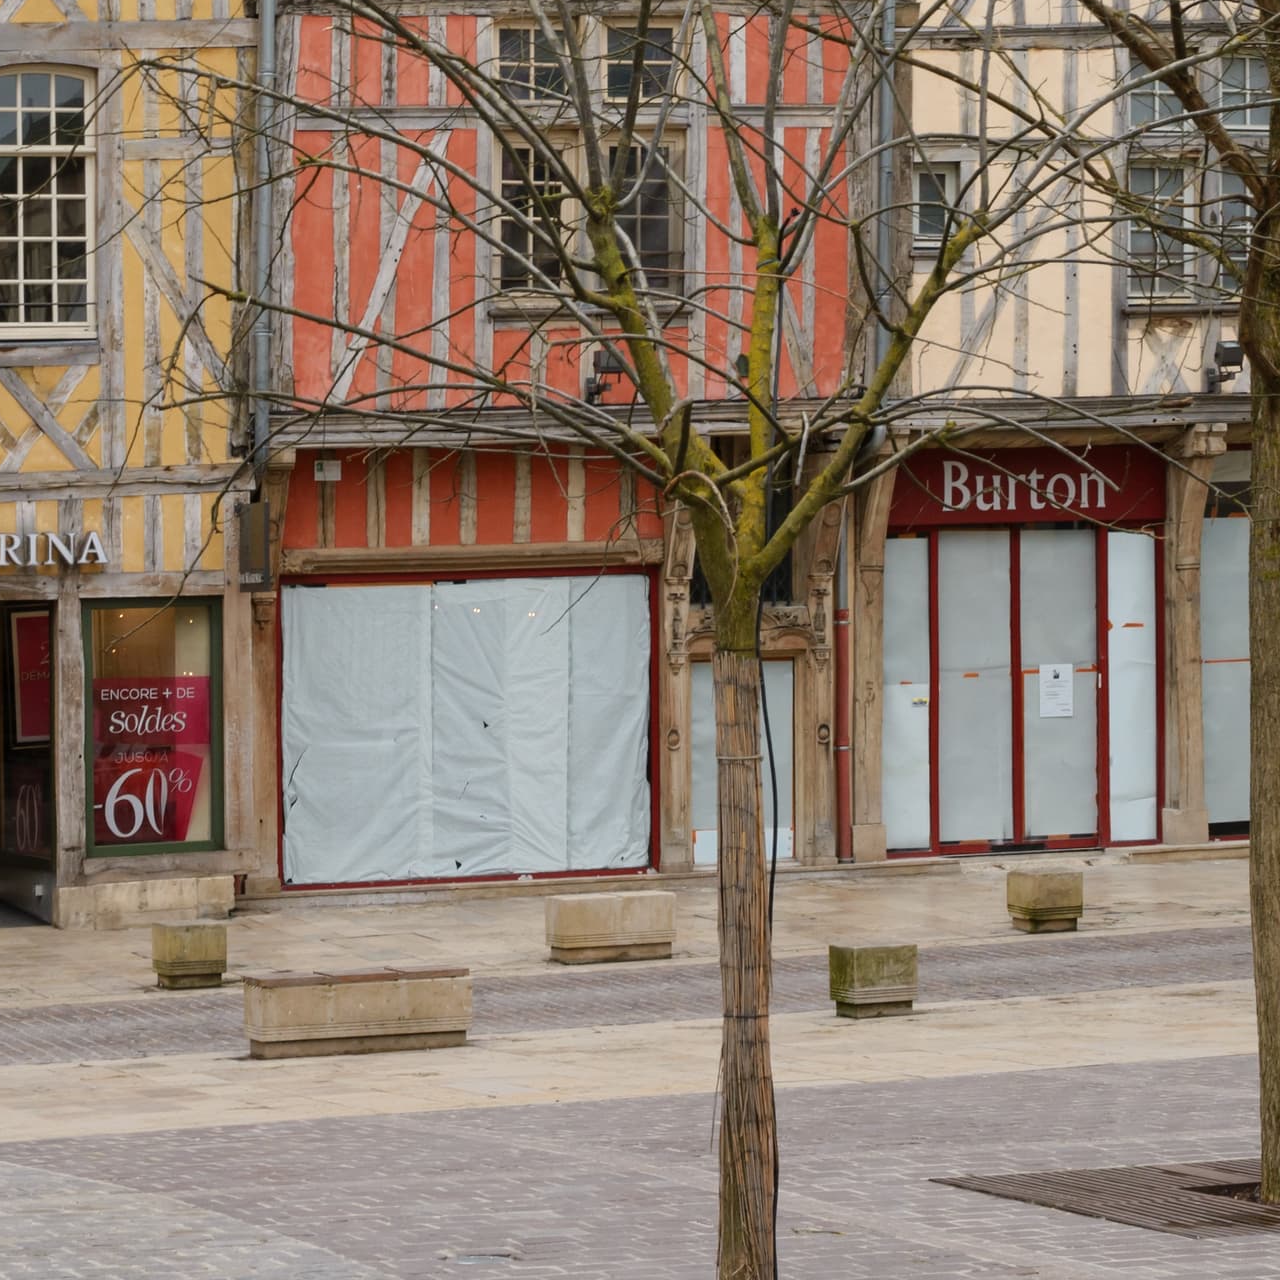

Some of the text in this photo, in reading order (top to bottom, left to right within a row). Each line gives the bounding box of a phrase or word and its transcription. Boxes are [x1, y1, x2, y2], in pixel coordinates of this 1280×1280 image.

[942, 459, 1107, 512] Burton
[100, 687, 159, 701] ENCORE
[176, 686, 195, 699] DE
[108, 705, 188, 736] soldes
